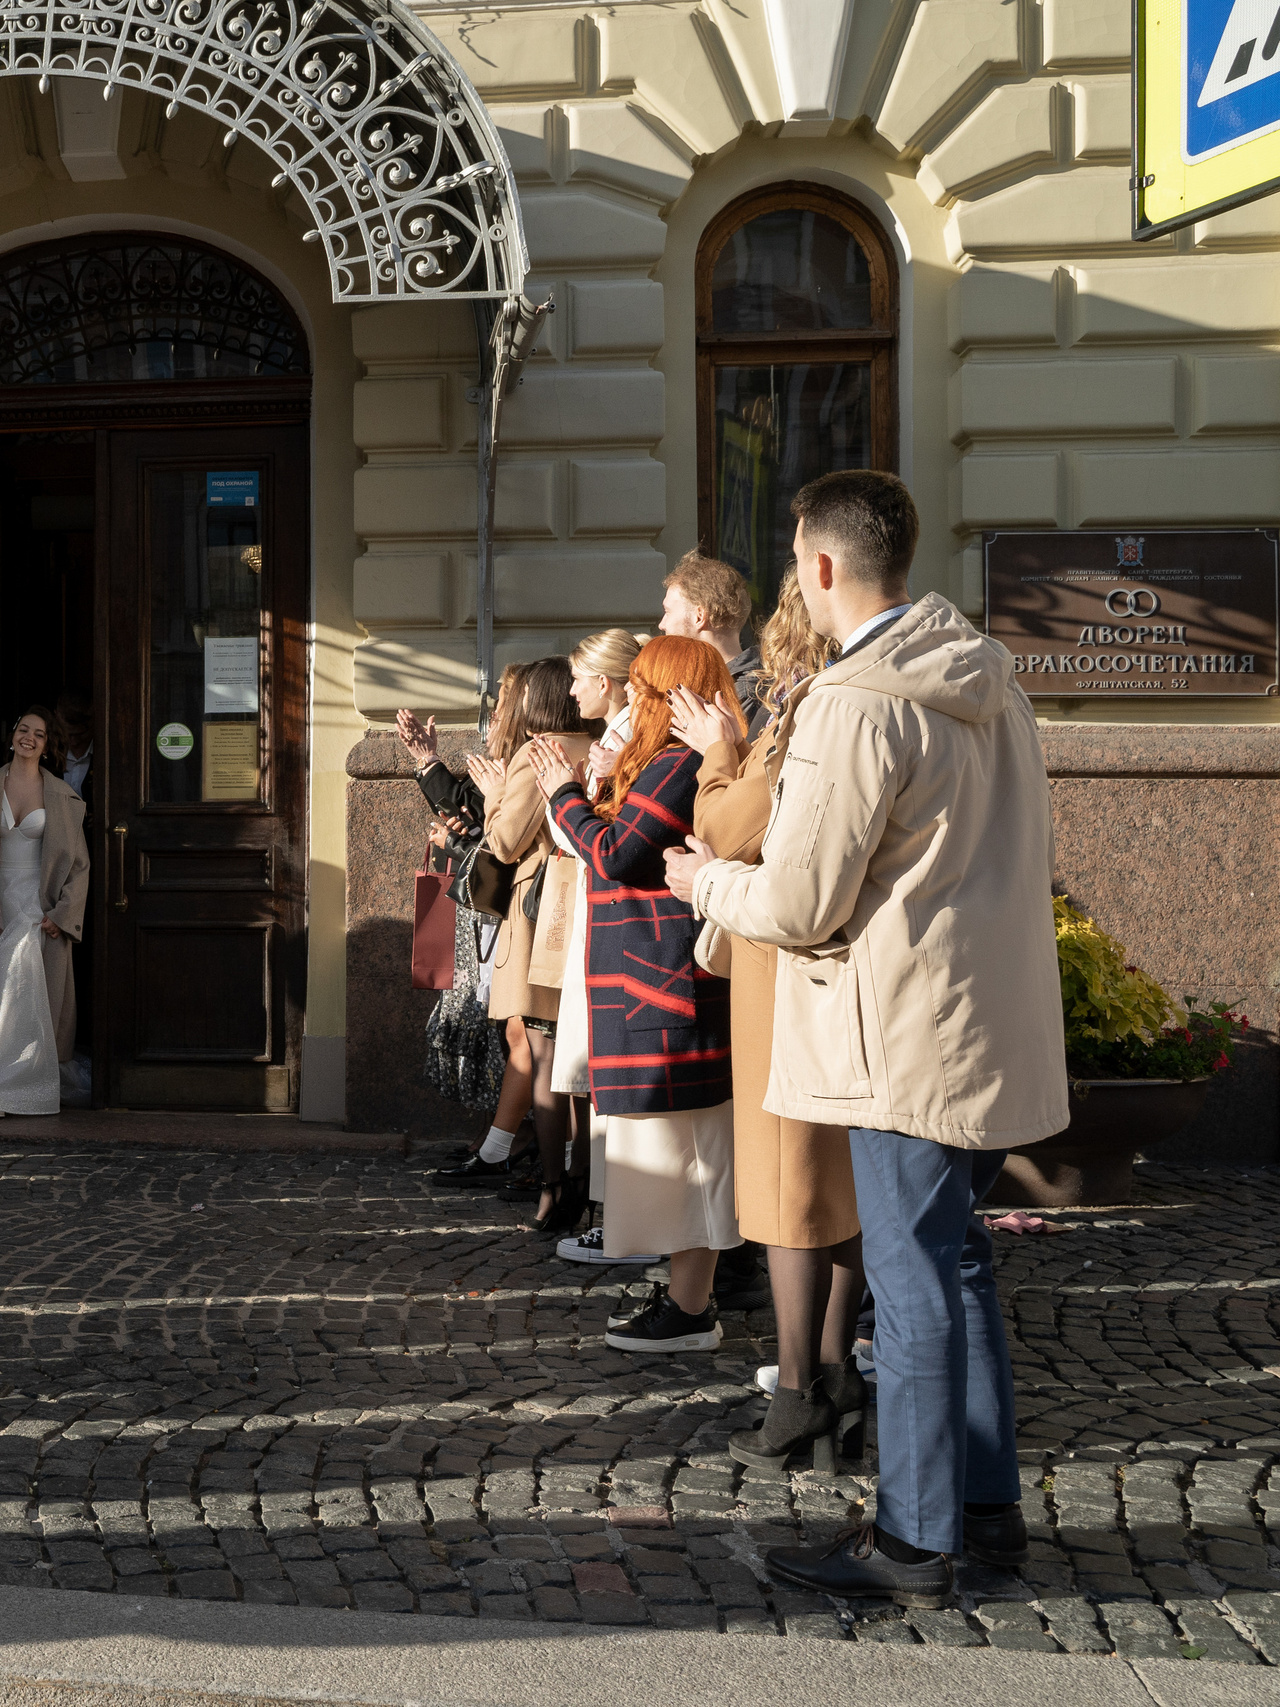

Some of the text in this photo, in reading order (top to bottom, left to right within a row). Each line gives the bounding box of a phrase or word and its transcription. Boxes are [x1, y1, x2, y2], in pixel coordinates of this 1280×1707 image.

[1077, 625, 1188, 647] ДВОРЕЦ
[1012, 654, 1255, 673] БРАКОСОЧЕТАНИЯ
[1171, 678, 1188, 689] 52
